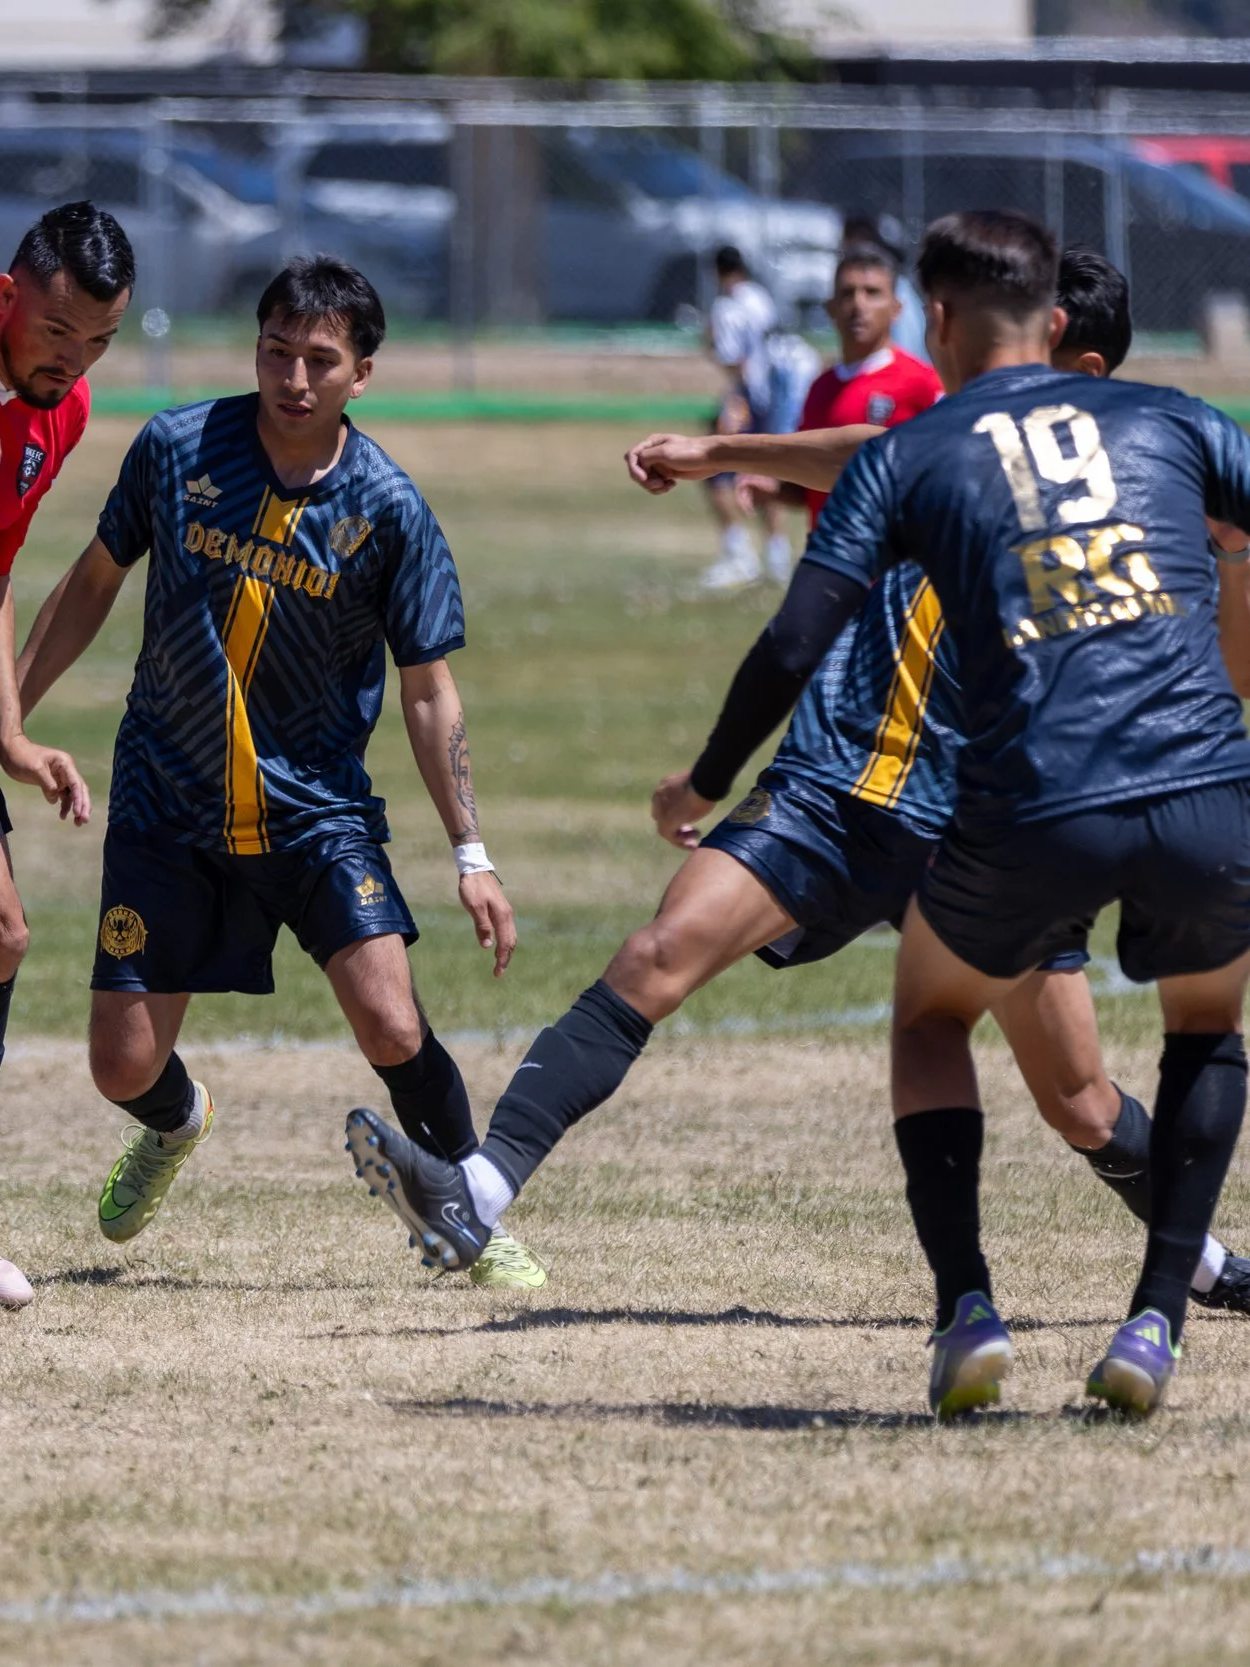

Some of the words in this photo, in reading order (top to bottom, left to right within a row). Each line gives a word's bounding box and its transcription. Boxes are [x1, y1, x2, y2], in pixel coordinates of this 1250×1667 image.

[35, 451, 44, 461] FC
[972, 403, 1118, 532] 19
[183, 494, 219, 508] SAINT
[183, 521, 341, 600] DEMONIOS
